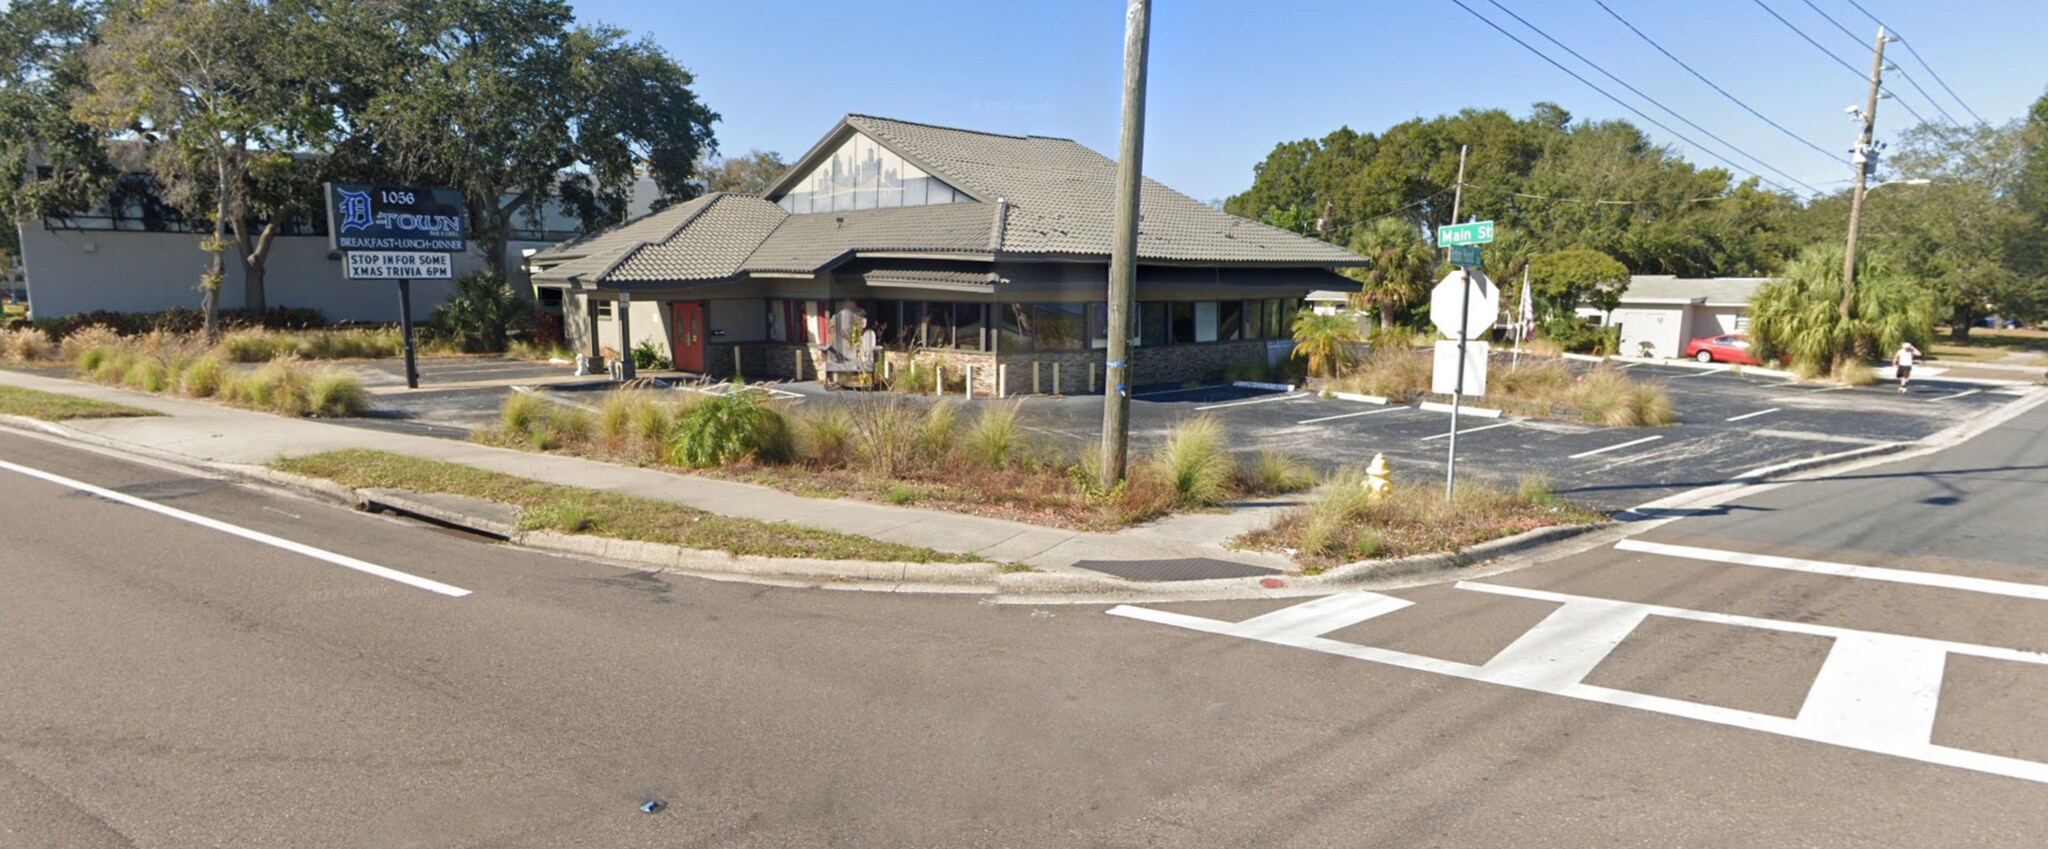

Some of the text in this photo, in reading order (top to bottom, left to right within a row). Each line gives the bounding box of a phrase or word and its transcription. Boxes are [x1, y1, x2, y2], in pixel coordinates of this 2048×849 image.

[381, 190, 415, 205] 1056
[1442, 226, 1491, 243] Main St
[350, 255, 379, 265] STOP
[420, 255, 447, 265] SOME
[352, 266, 447, 277] XMAS TRIVIA 6PM
